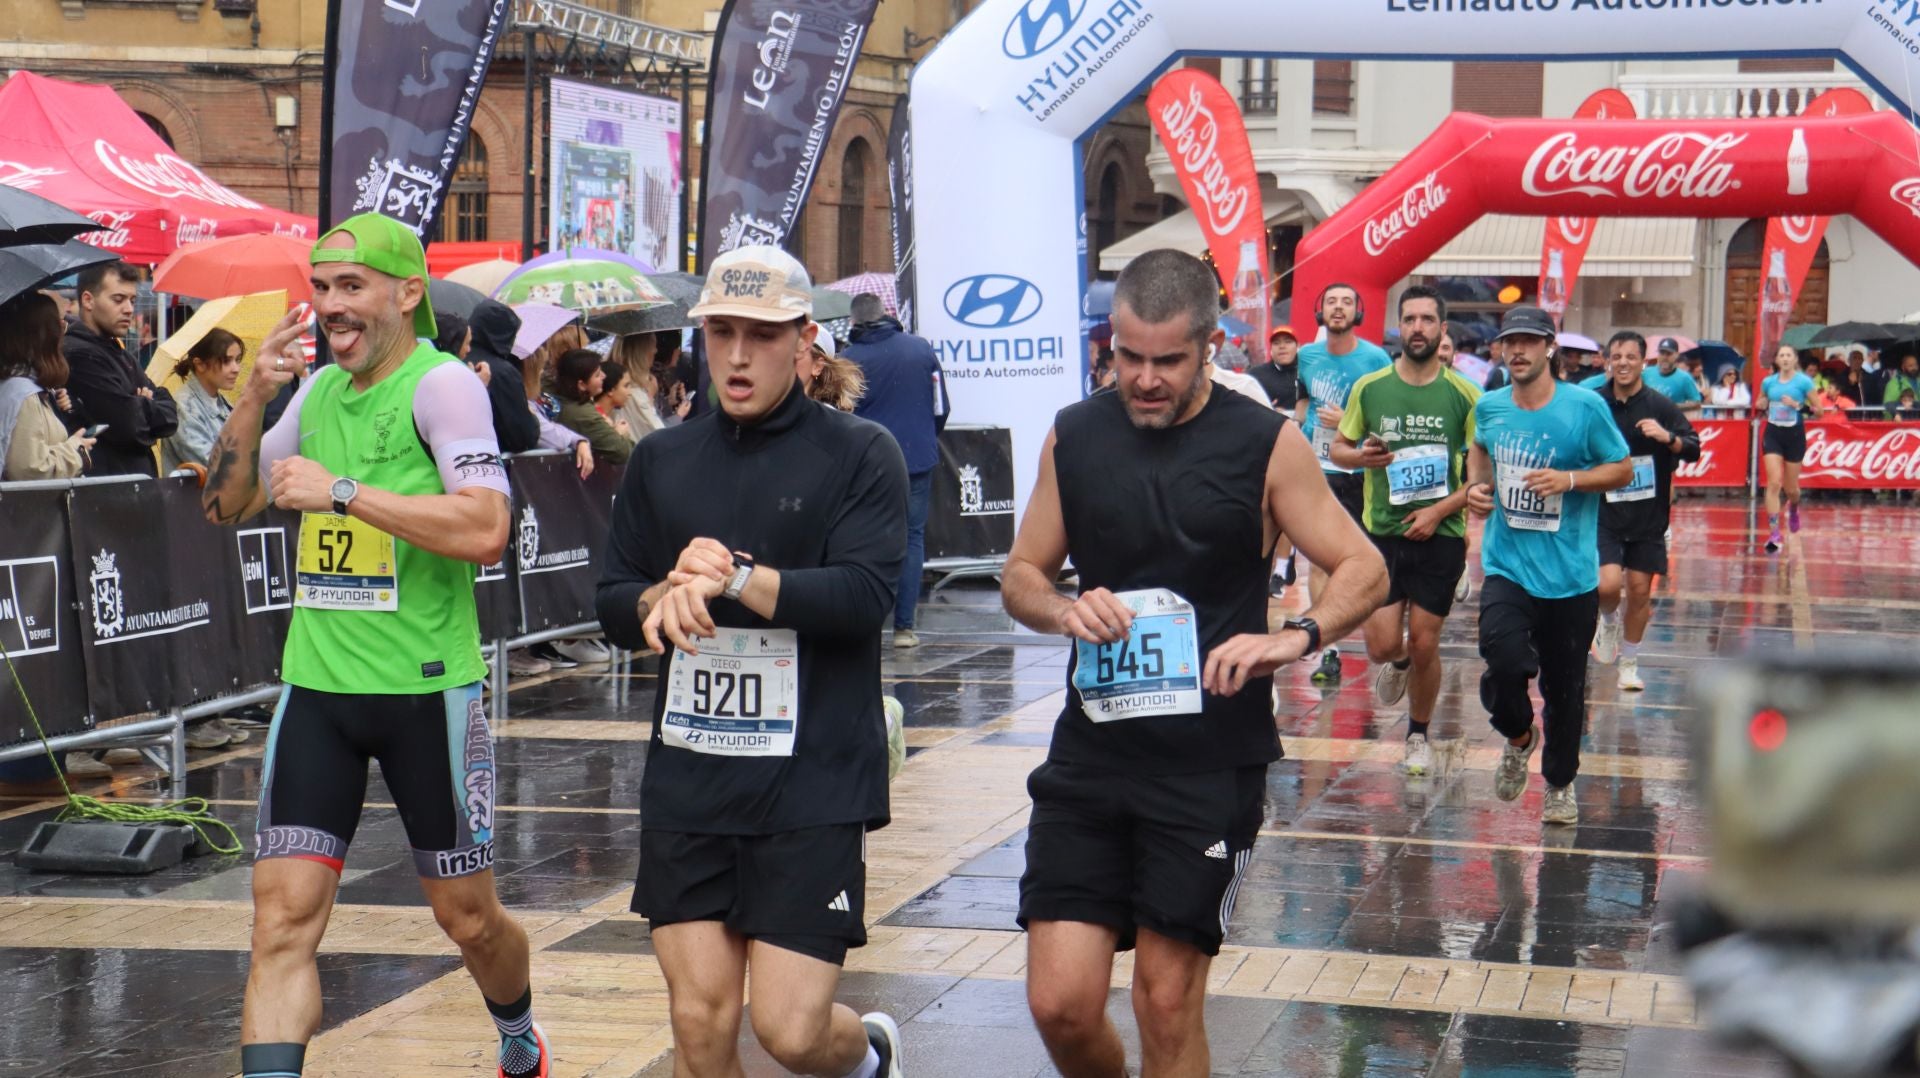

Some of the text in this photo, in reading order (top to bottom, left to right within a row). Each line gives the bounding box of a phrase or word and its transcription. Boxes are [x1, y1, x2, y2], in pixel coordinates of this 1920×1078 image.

[1016, 0, 1143, 112] HYUNDAI
[1036, 12, 1154, 122] Lemauto Automoción
[440, 1, 504, 170] AYUNTAMIENTO
[780, 22, 859, 225] AYUNTAMIENTO DE LEÓN
[1522, 131, 1749, 199] Coca-Cola
[1363, 170, 1447, 256] Coca-Cola
[722, 269, 771, 283] GO ONE
[724, 283, 767, 297] MORE
[930, 336, 1063, 362] HYUNDAI
[942, 364, 1064, 378] mauto Automoción
[1405, 414, 1444, 429] aecc
[1402, 464, 1435, 487] 339
[1508, 487, 1545, 512] 1198
[325, 517, 347, 527] JAIME
[319, 530, 353, 573] 52
[271, 577, 279, 586] ES
[321, 591, 374, 600] HYUNDAI
[25, 616, 35, 626] ES
[126, 606, 184, 632] AYUNTAMIENT
[192, 598, 209, 618] LEÓN
[711, 658, 741, 669] DIEGO
[1096, 633, 1164, 684] 645
[693, 669, 762, 718] 920
[1115, 694, 1177, 709] HYUNDAI
[708, 734, 772, 747] HYUNDAI
